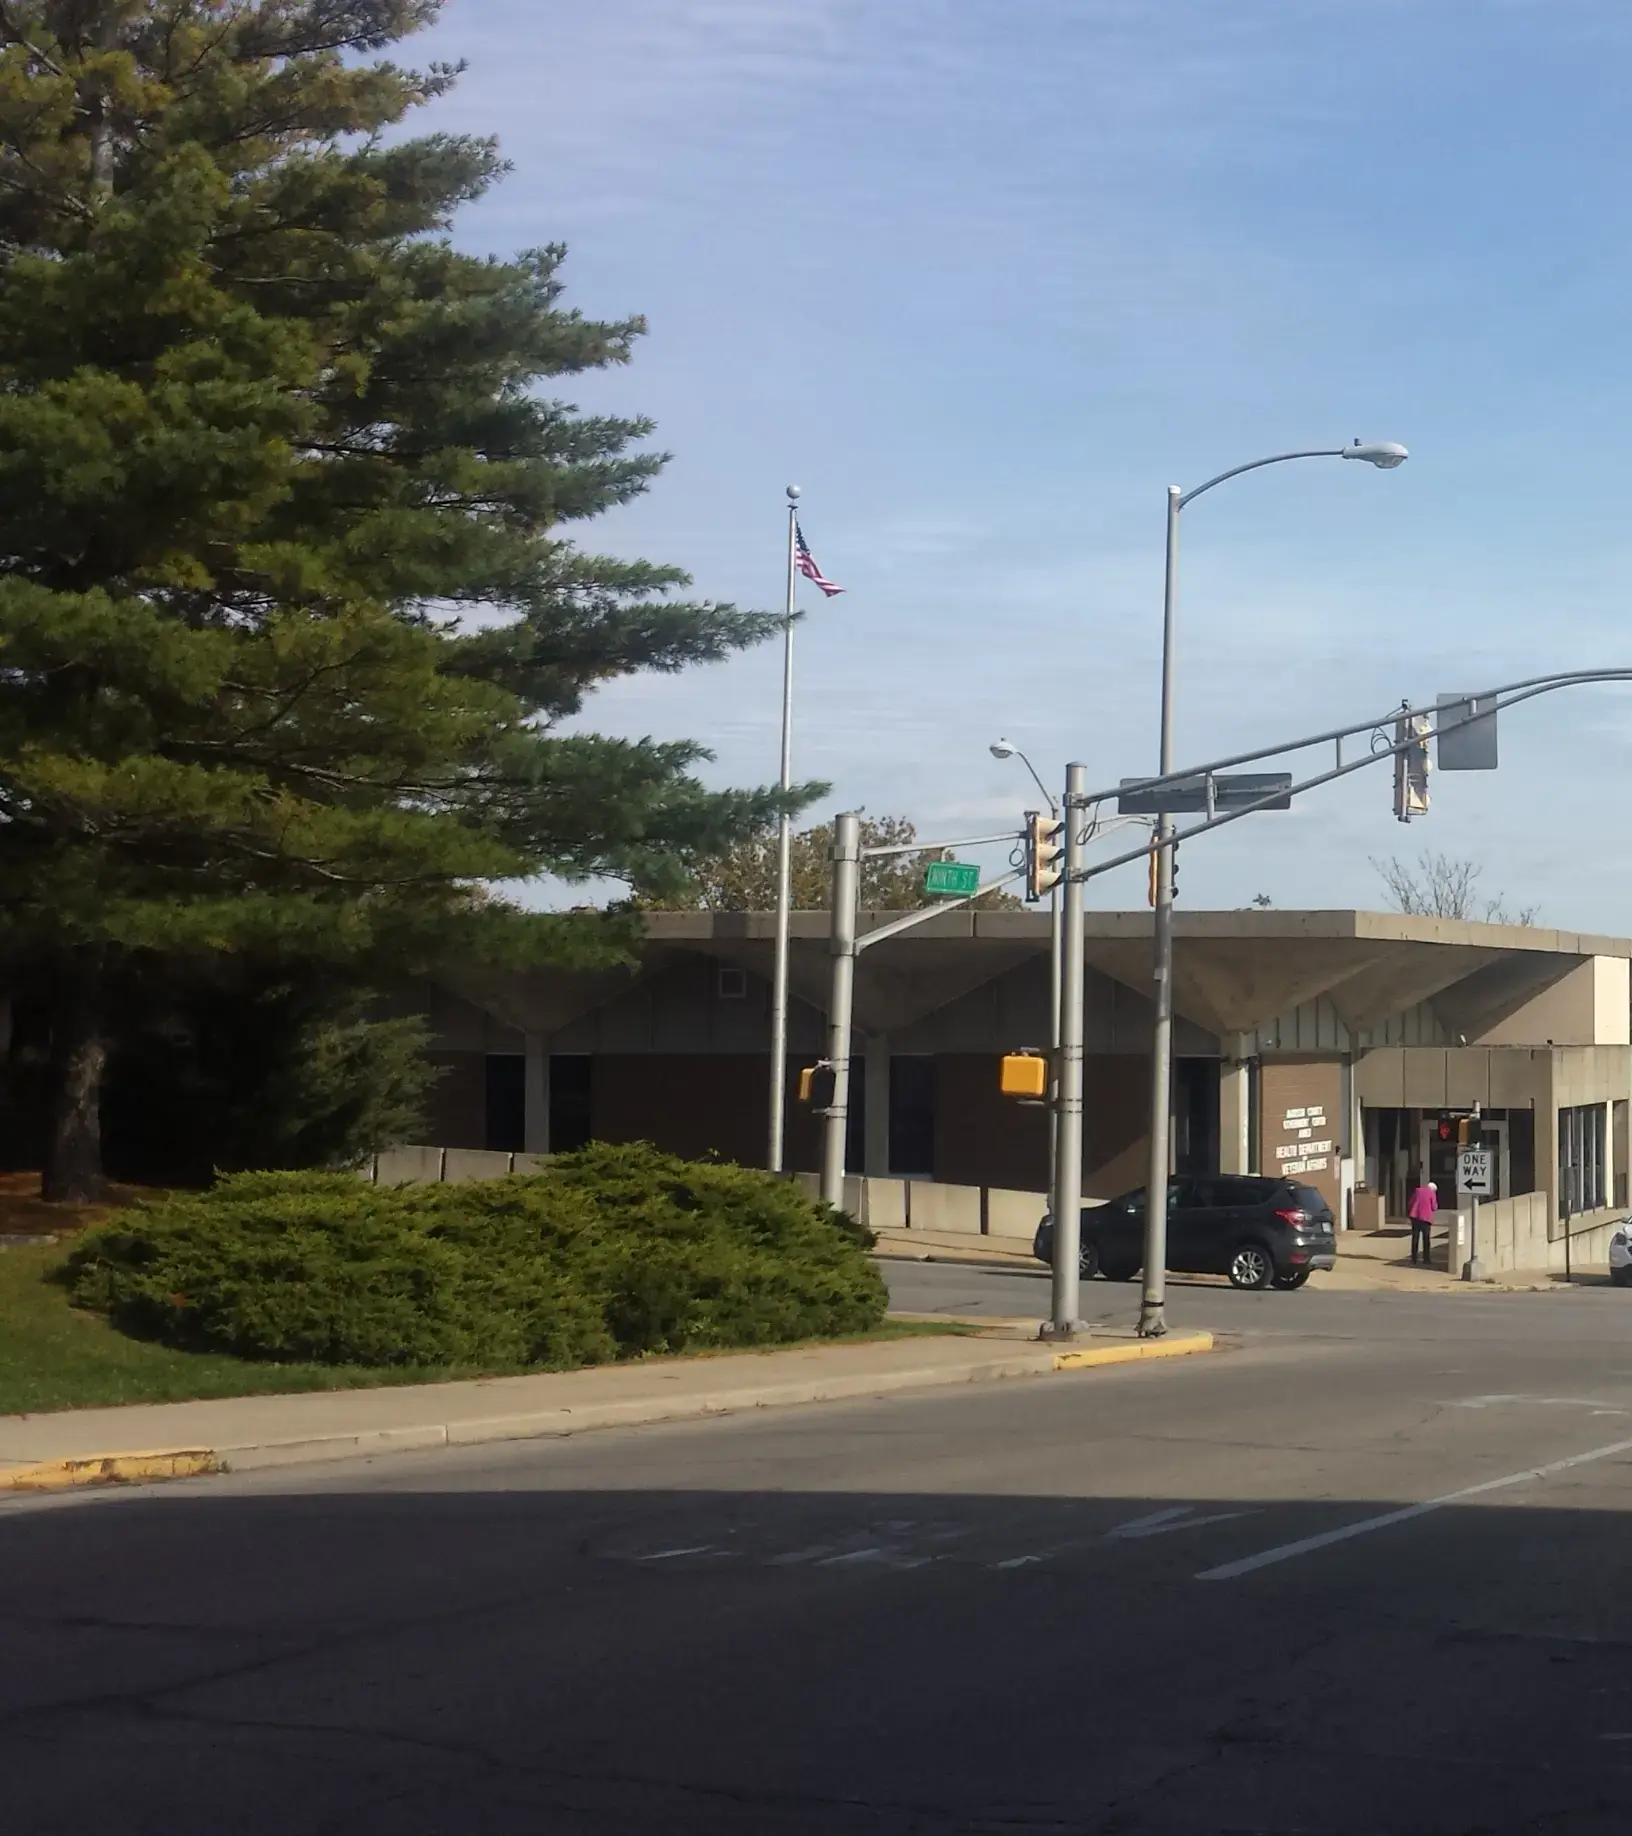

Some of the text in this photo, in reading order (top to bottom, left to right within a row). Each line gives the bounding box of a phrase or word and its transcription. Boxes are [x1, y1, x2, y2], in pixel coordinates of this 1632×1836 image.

[962, 871, 975, 889] ST
[1463, 1154, 1487, 1165] ONE
[1463, 1166, 1487, 1177] WAY
